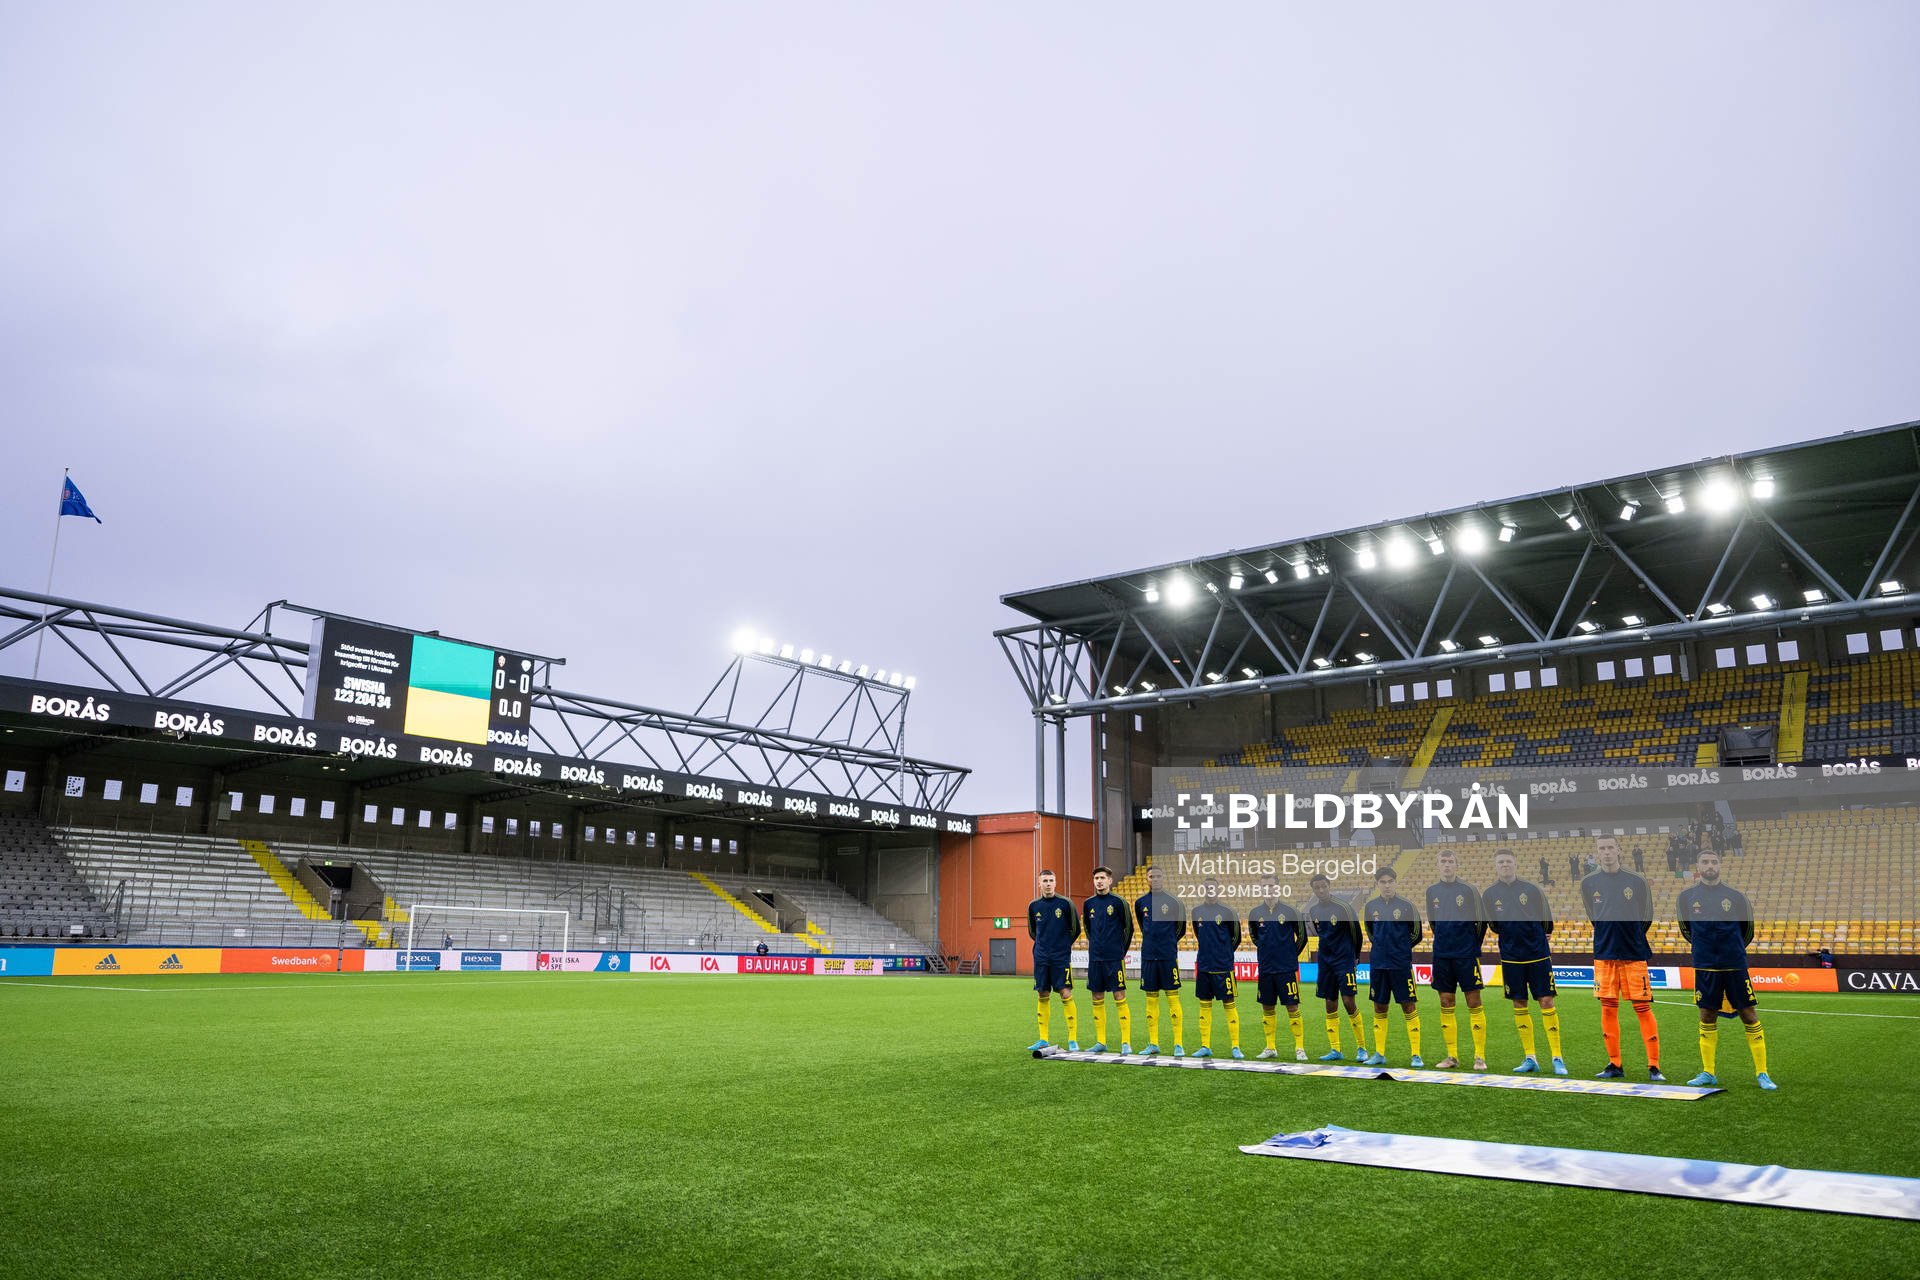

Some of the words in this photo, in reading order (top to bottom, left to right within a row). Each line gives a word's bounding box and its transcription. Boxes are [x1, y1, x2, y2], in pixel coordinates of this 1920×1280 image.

[495, 669, 506, 690] 0
[520, 673, 530, 694] 0
[334, 688, 354, 703] 123
[355, 691, 376, 707] 204
[376, 694, 391, 709] 34
[30, 694, 111, 722] BORÅS
[498, 698, 522, 718] 0.0
[154, 711, 225, 736] BORÅS
[253, 724, 318, 749] BORÅS
[487, 729, 529, 747] BORÅS
[339, 736, 398, 759] BORÅS
[420, 746, 473, 768] BORÅS
[493, 757, 542, 777] BORÅS
[560, 765, 605, 785] BORÅS
[1742, 763, 1797, 781] BORÅS
[1821, 758, 1882, 777] BORÅS
[622, 773, 664, 793] BORÅS
[1530, 777, 1577, 795] BORÅS
[1598, 773, 1648, 791] BORÅS
[1667, 768, 1720, 787] BORÅS
[685, 782, 724, 801] BORÅS
[737, 789, 773, 808] BORÅS
[784, 796, 817, 814] BORÅS
[829, 802, 860, 818] BORÅS
[1141, 804, 1175, 820] BORÅS
[871, 808, 900, 825] BORÅS
[910, 814, 937, 830] BORÅS
[947, 818, 972, 834] BORÅS
[271, 956, 318, 966] Swedbank
[551, 956, 580, 964] SVESKA
[650, 956, 671, 971] ICA
[700, 957, 720, 971] ICA
[746, 958, 808, 971] BAUHAUS
[1065, 968, 1070, 980] 7
[1117, 970, 1123, 982] 8
[1172, 968, 1178, 980] 9
[1345, 972, 1356, 986] 11
[1750, 975, 1784, 984] dbank
[1225, 977, 1232, 990] 6
[1286, 981, 1297, 995] 10
[1407, 978, 1413, 992] 5
[1642, 976, 1648, 991] 1
[1744, 979, 1752, 995] 3
